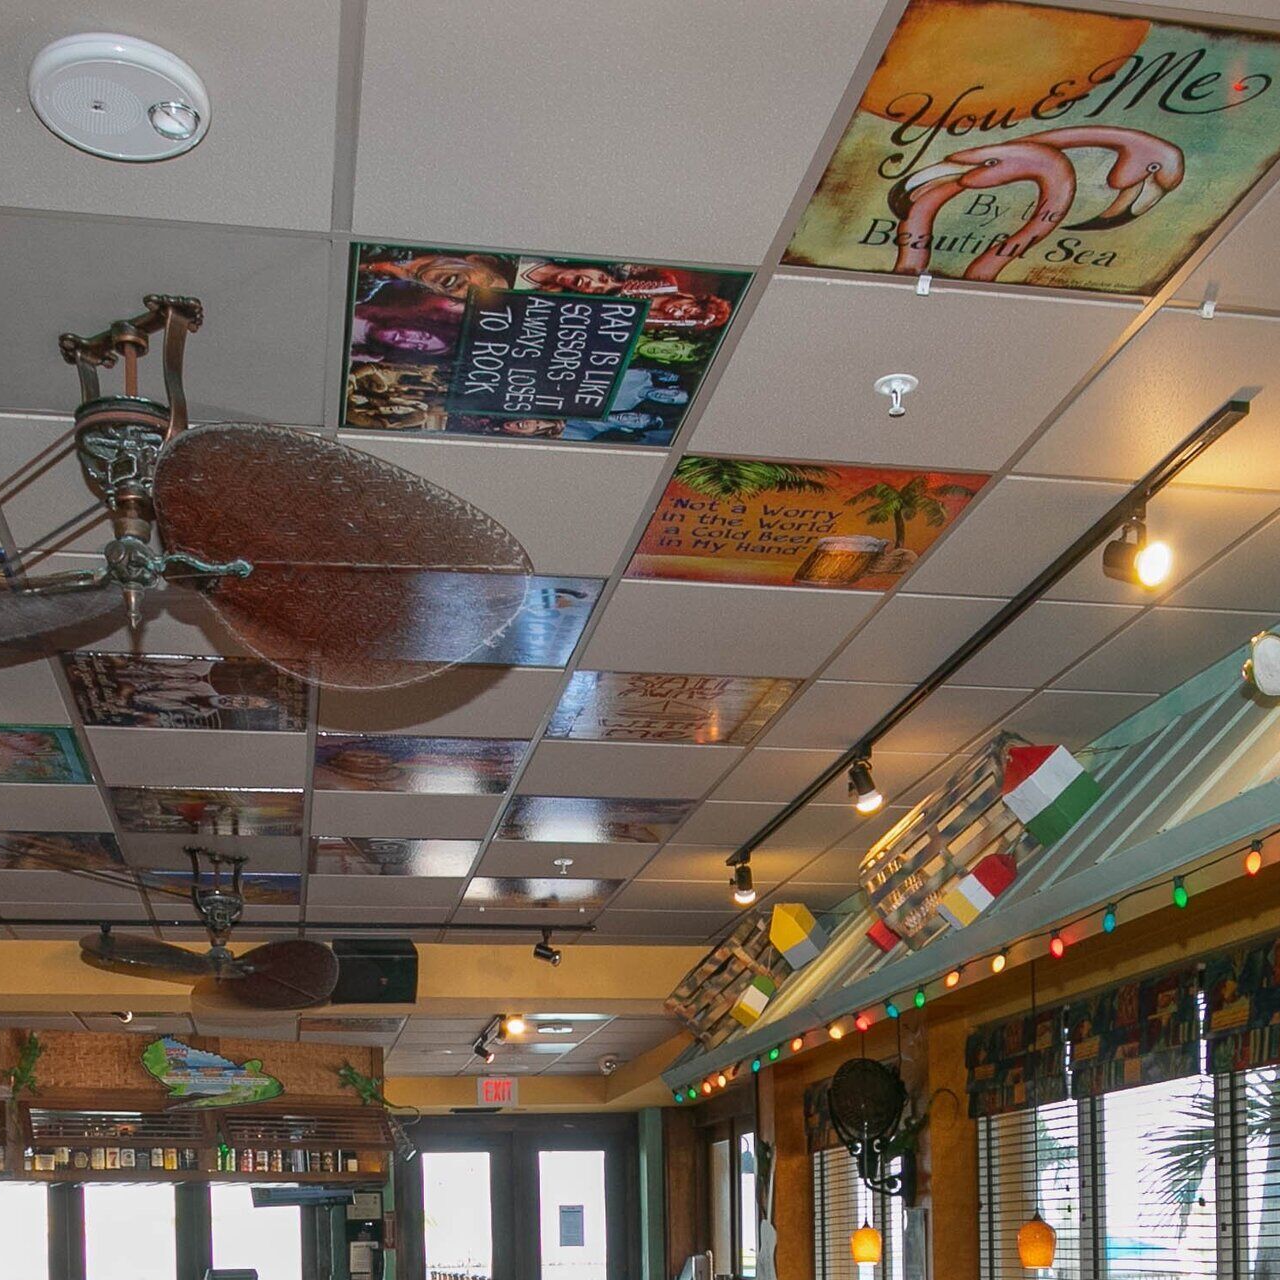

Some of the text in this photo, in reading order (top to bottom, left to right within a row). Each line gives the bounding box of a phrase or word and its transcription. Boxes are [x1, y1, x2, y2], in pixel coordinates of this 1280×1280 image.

[878, 47, 1271, 179] You & Me
[963, 193, 1066, 226] By the
[859, 219, 1117, 267] Beautiful Sea
[464, 306, 513, 395] TO ROCK
[503, 296, 556, 412] ALWAYS LOSES
[575, 303, 636, 408] RAP IS LIKE
[535, 394, 565, 411] IT
[661, 511, 686, 523] in
[698, 513, 744, 527] the
[731, 504, 748, 515] a
[762, 503, 843, 523] Worry
[658, 537, 683, 548] in
[691, 539, 724, 554] My
[664, 526, 820, 545] a Cold Beer
[483, 1079, 513, 1103] EXIT
